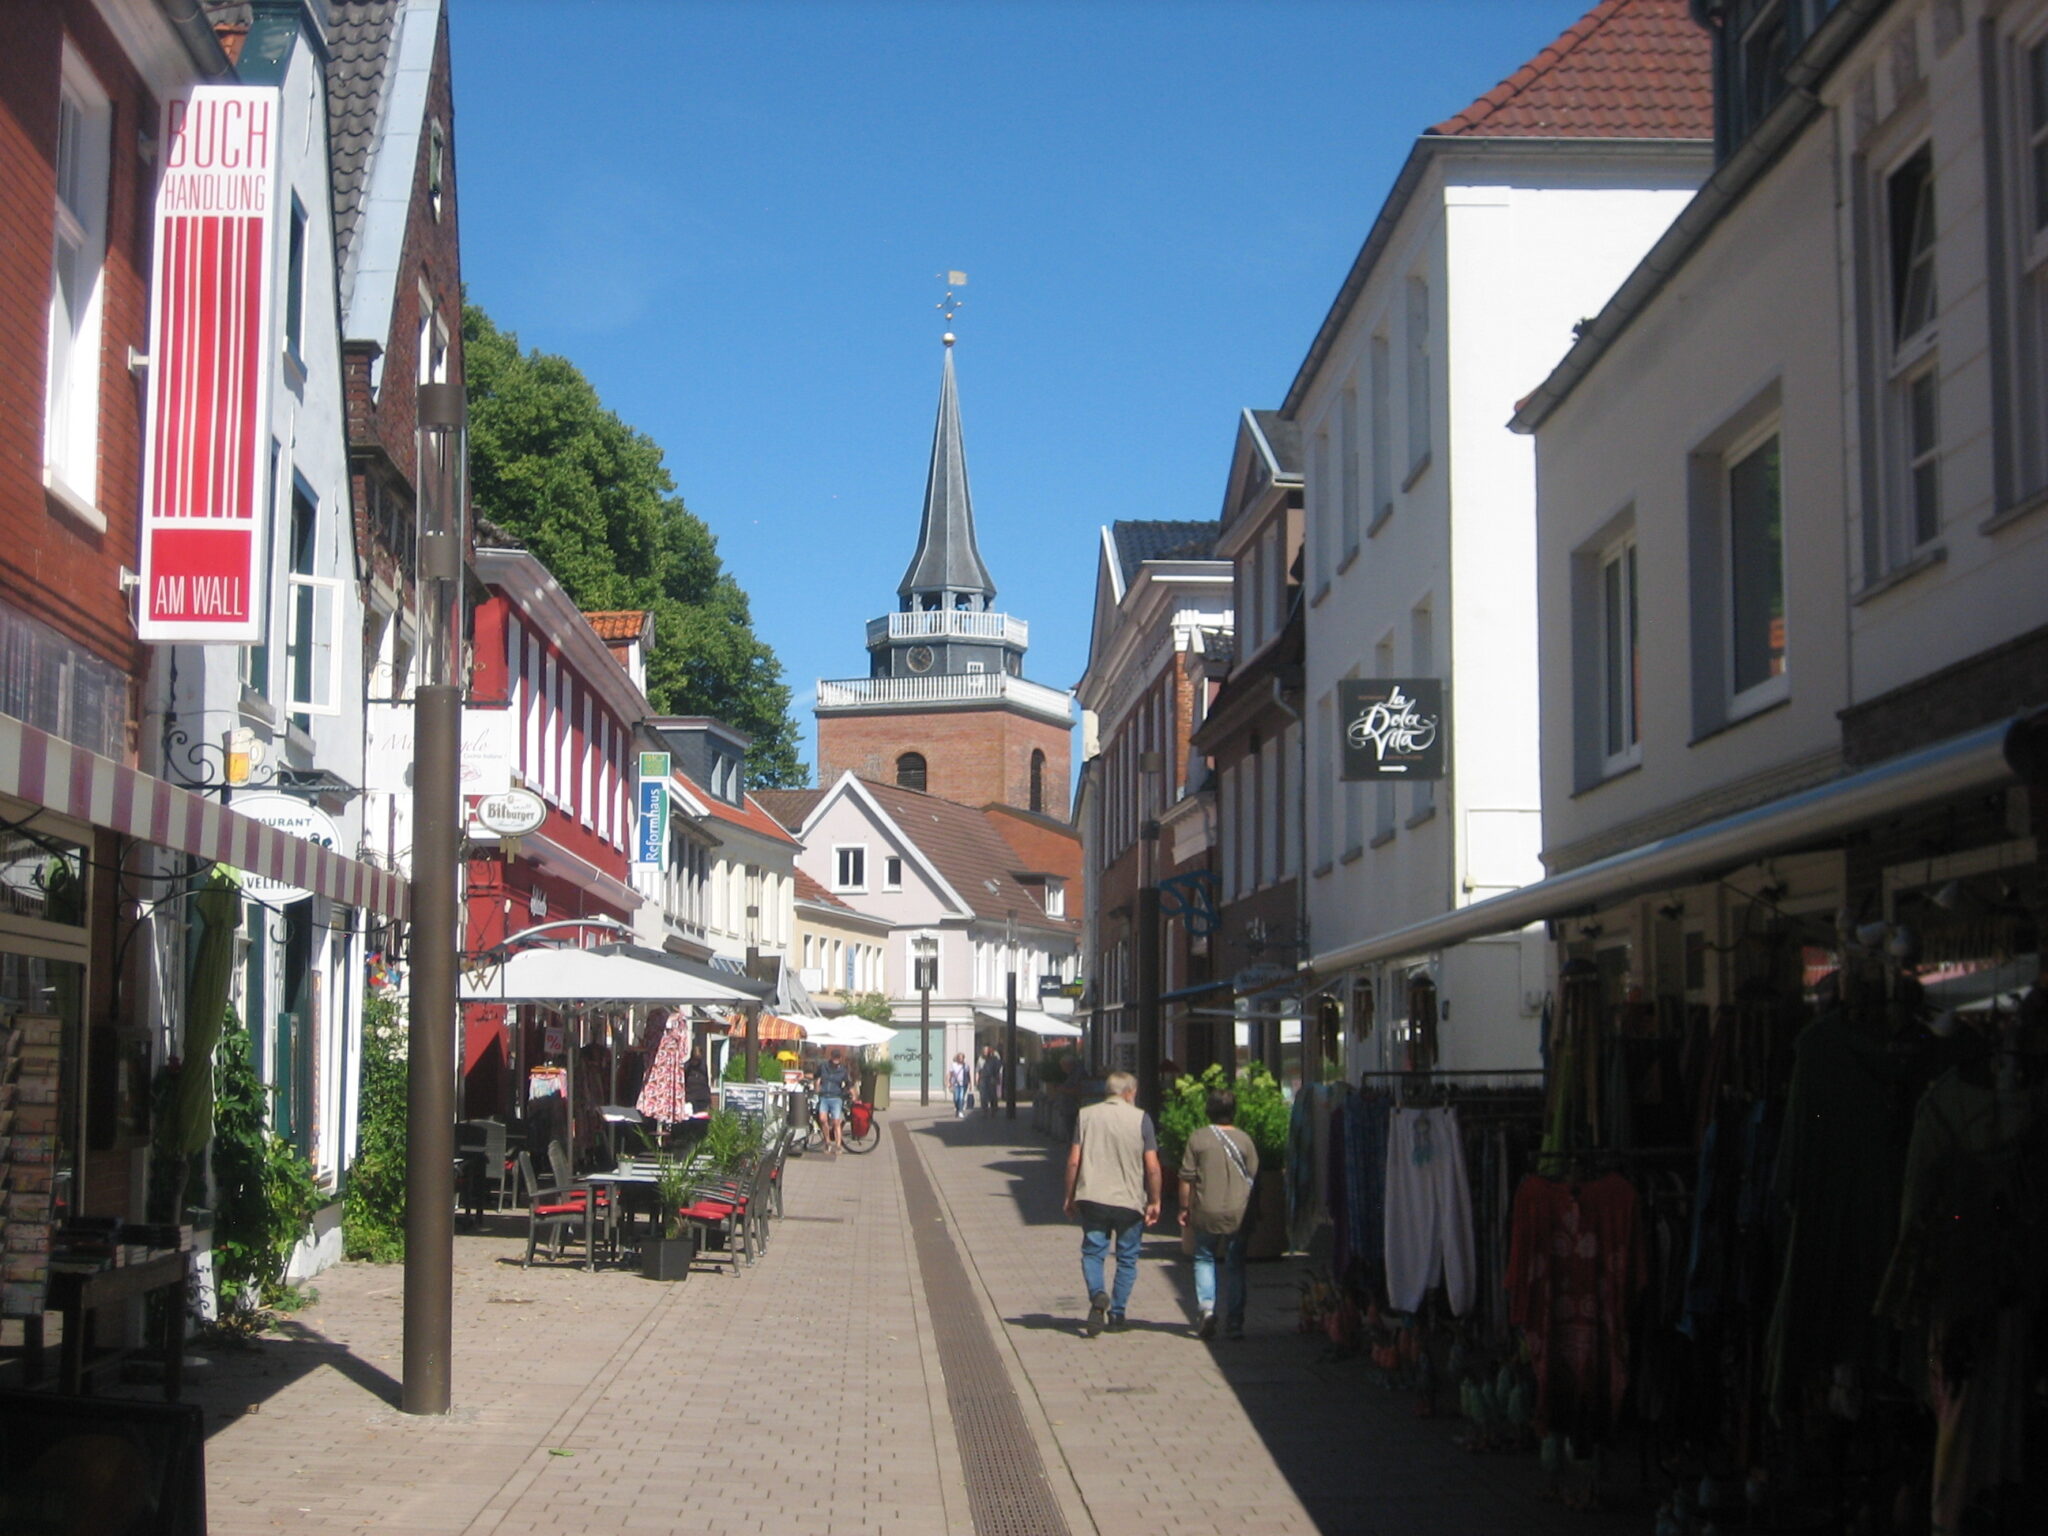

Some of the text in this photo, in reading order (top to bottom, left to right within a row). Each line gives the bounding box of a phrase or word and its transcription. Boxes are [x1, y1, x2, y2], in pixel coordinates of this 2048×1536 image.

[166, 99, 269, 169] BUCH
[164, 173, 267, 212] HANDLUNG
[154, 574, 244, 617] AM WALL
[487, 802, 536, 822] Bitburger
[640, 787, 664, 861] Reformhaus
